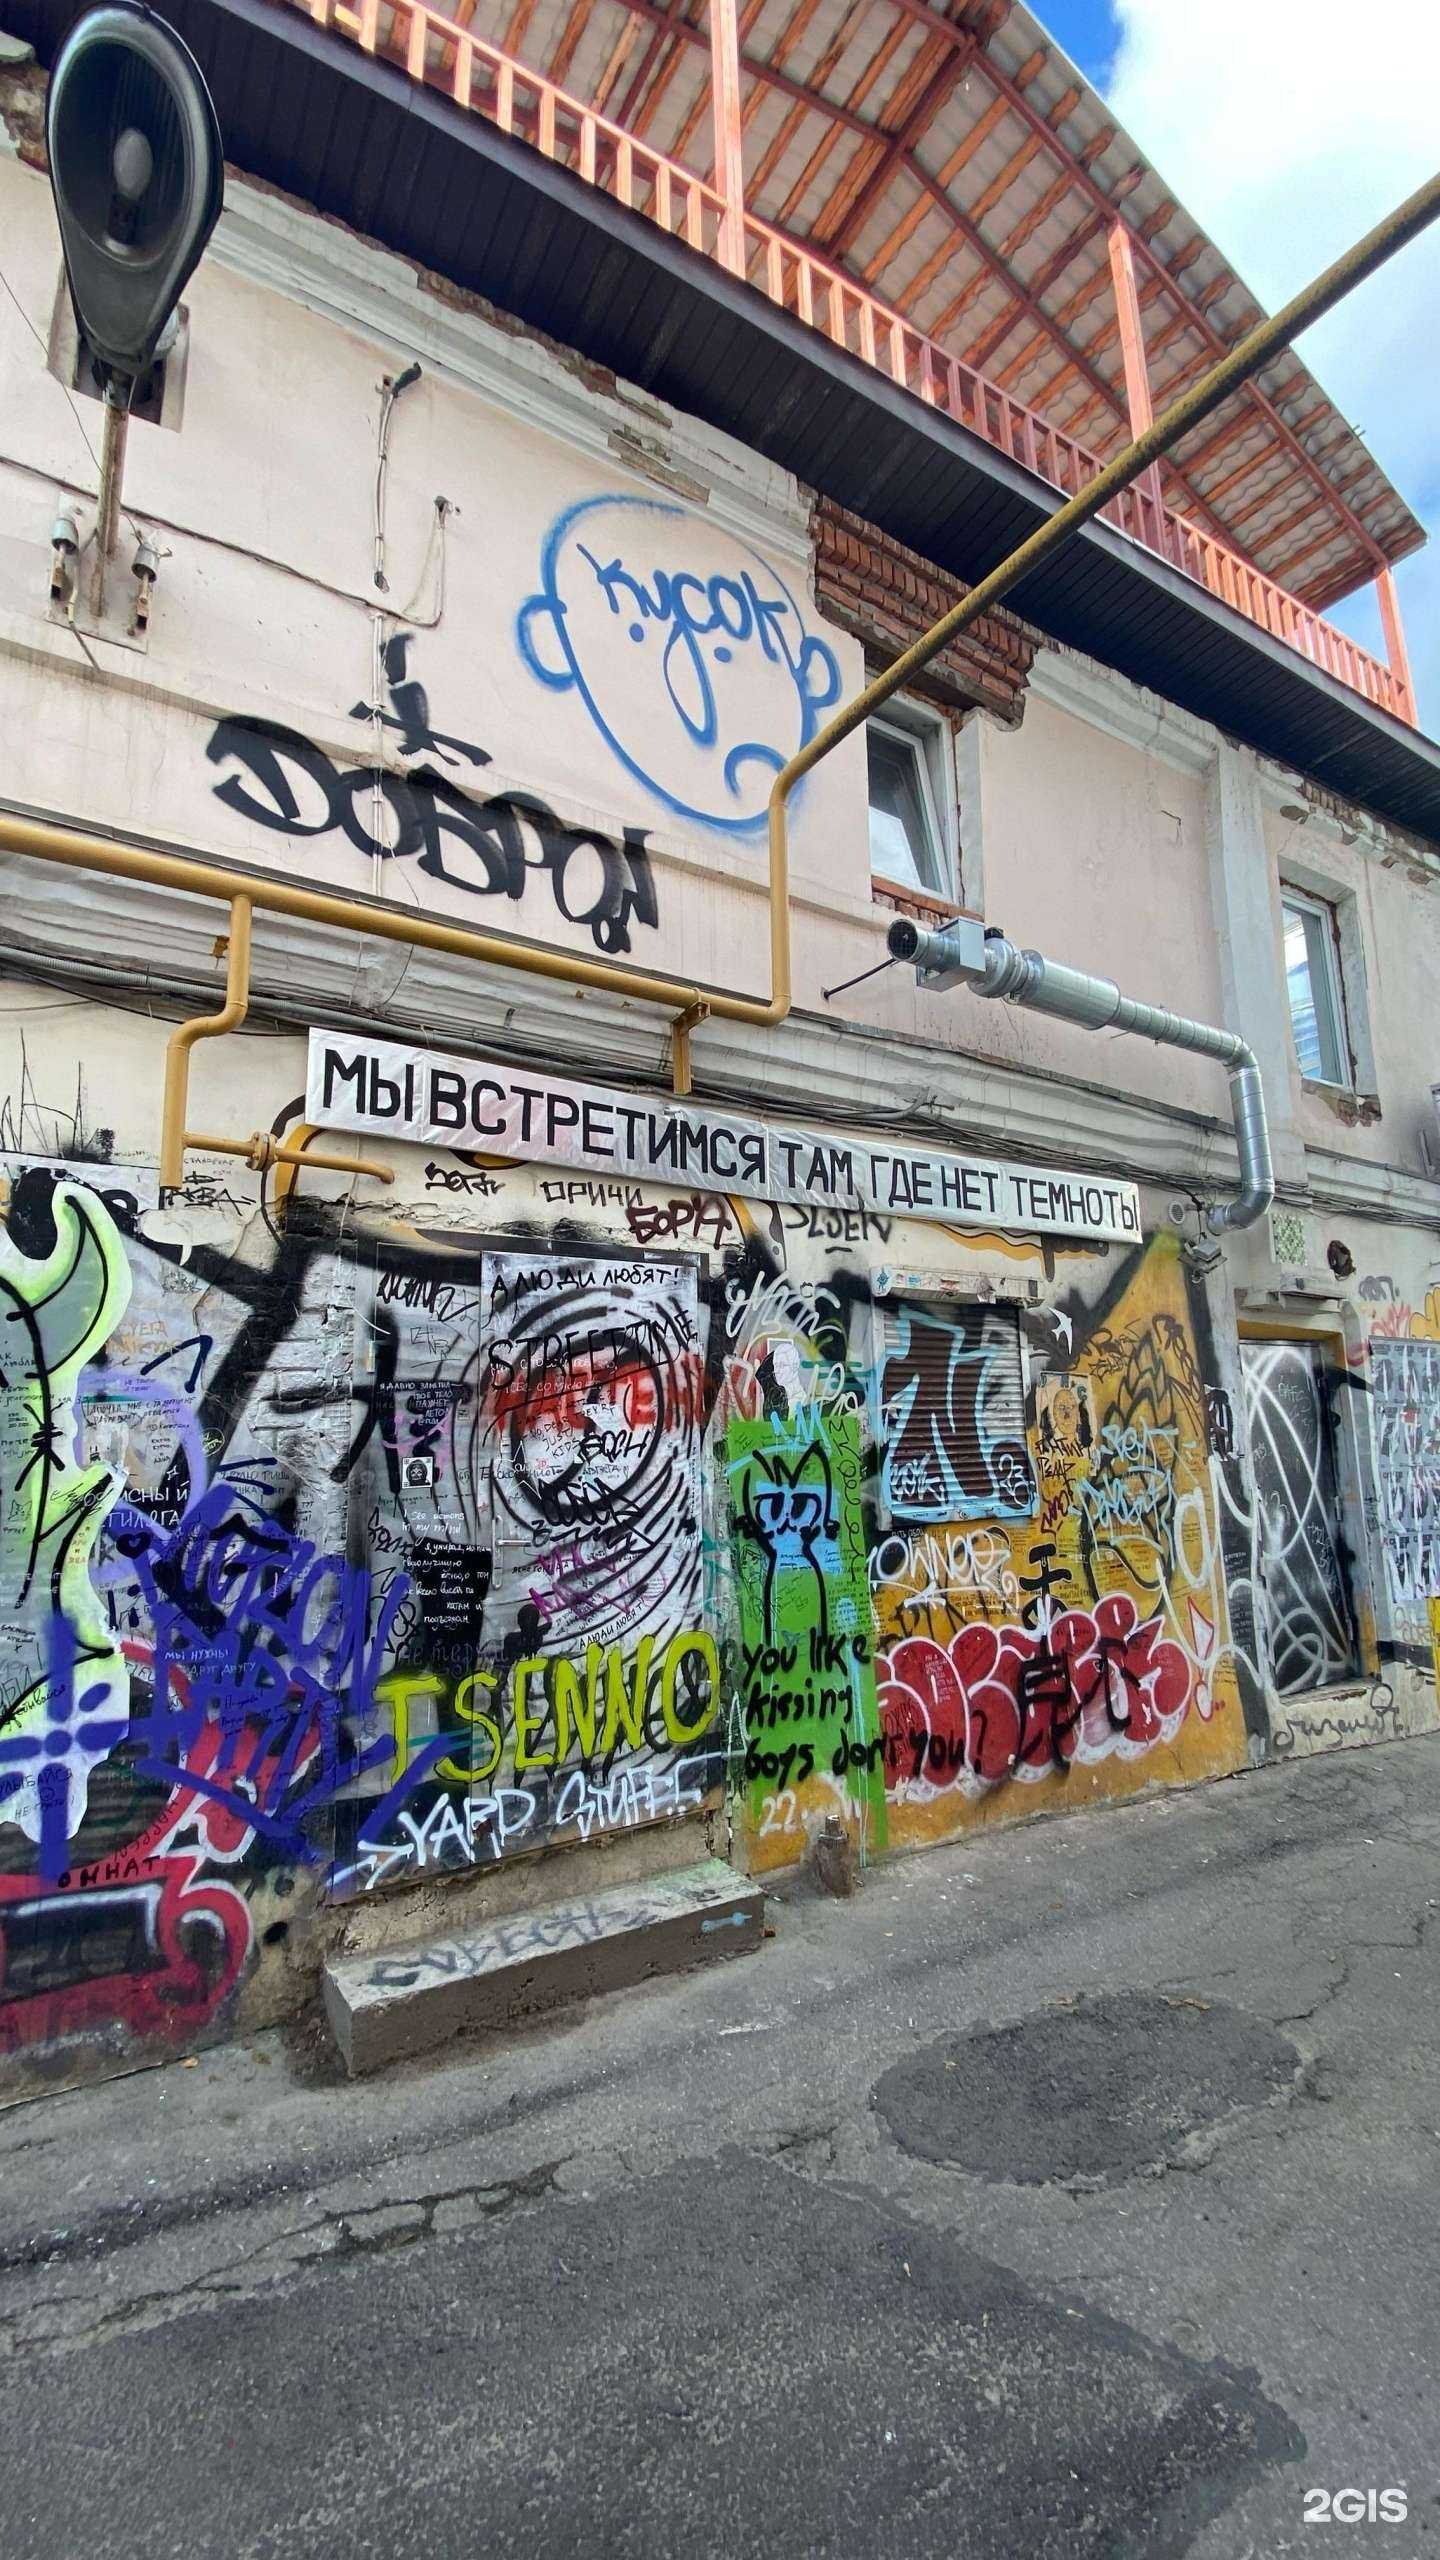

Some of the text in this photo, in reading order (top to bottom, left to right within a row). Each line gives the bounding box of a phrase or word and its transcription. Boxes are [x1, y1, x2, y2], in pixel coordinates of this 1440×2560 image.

[322, 1048, 415, 1123] МЫ
[429, 1069, 766, 1184] ВСТРЕТИМСЯ
[779, 1141, 854, 1196] ТАМ
[870, 1155, 933, 1209] ГДЕ
[940, 1165, 999, 1212] НЕТ
[1010, 1175, 1140, 1233] ТЕМНОТЫ
[165, 1651, 185, 1660] МЫ
[742, 1627, 871, 1690] you like
[745, 1737, 815, 1792] boys
